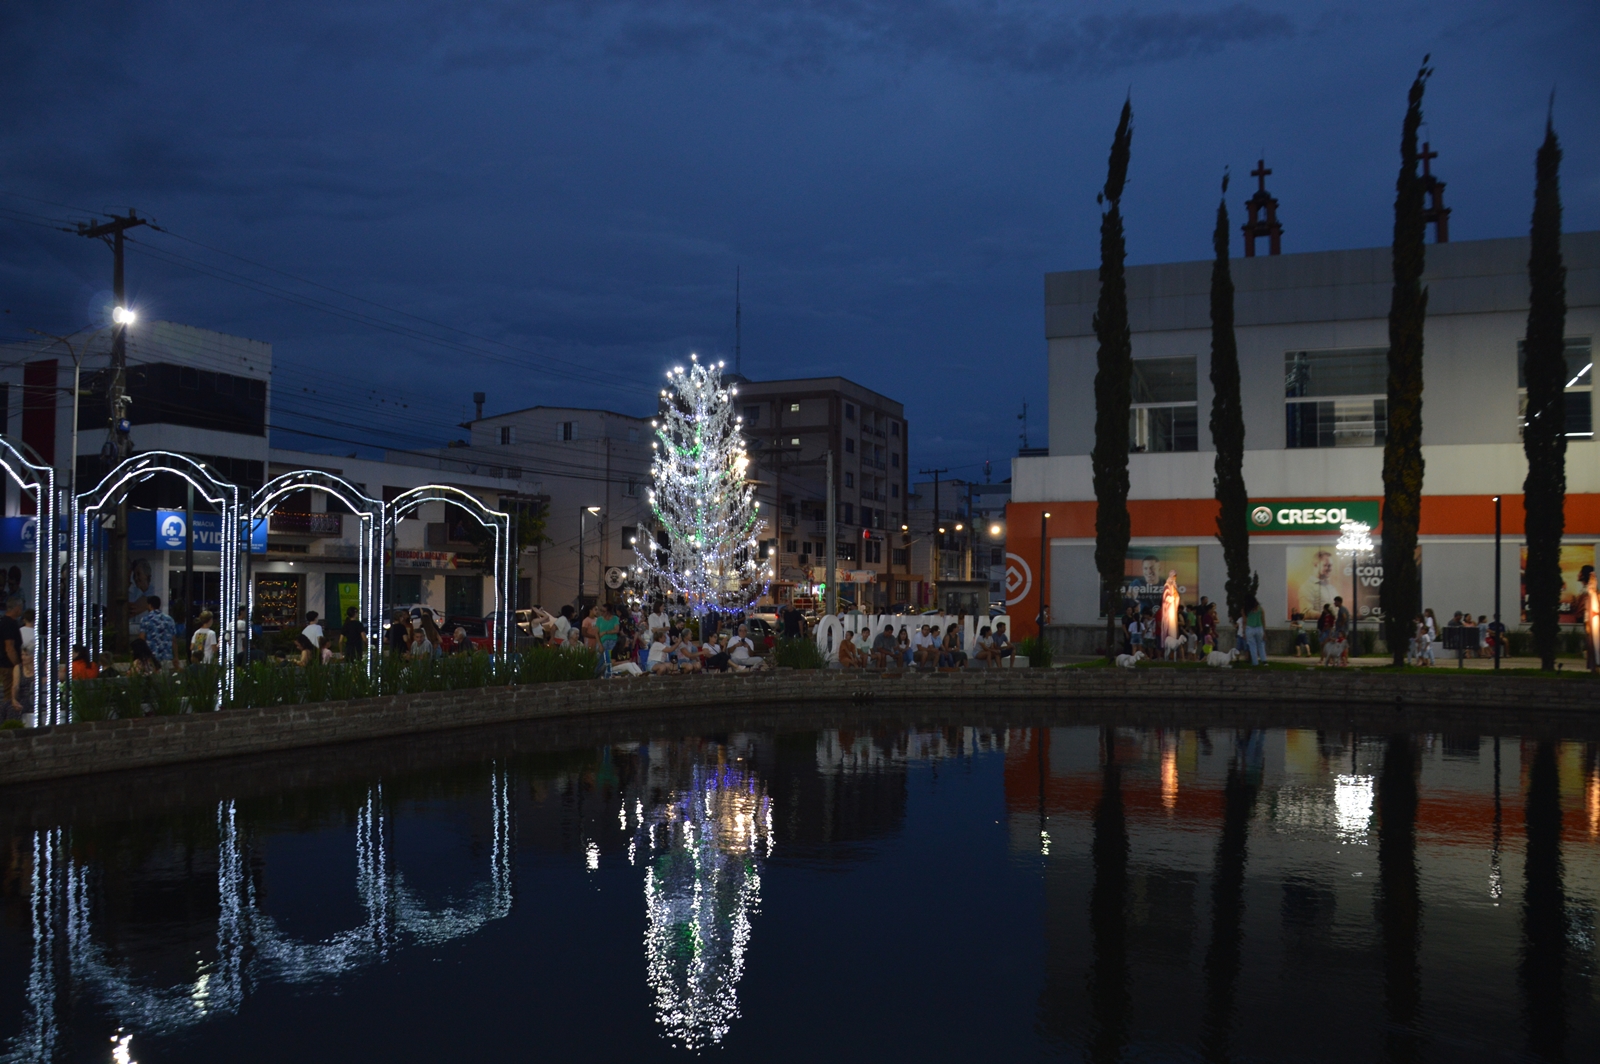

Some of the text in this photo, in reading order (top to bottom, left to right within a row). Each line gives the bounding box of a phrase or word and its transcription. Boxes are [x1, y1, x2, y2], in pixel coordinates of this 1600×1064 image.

[1276, 508, 1353, 525] CRESOL
[1356, 566, 1384, 576] con
[1361, 577, 1384, 587] vo
